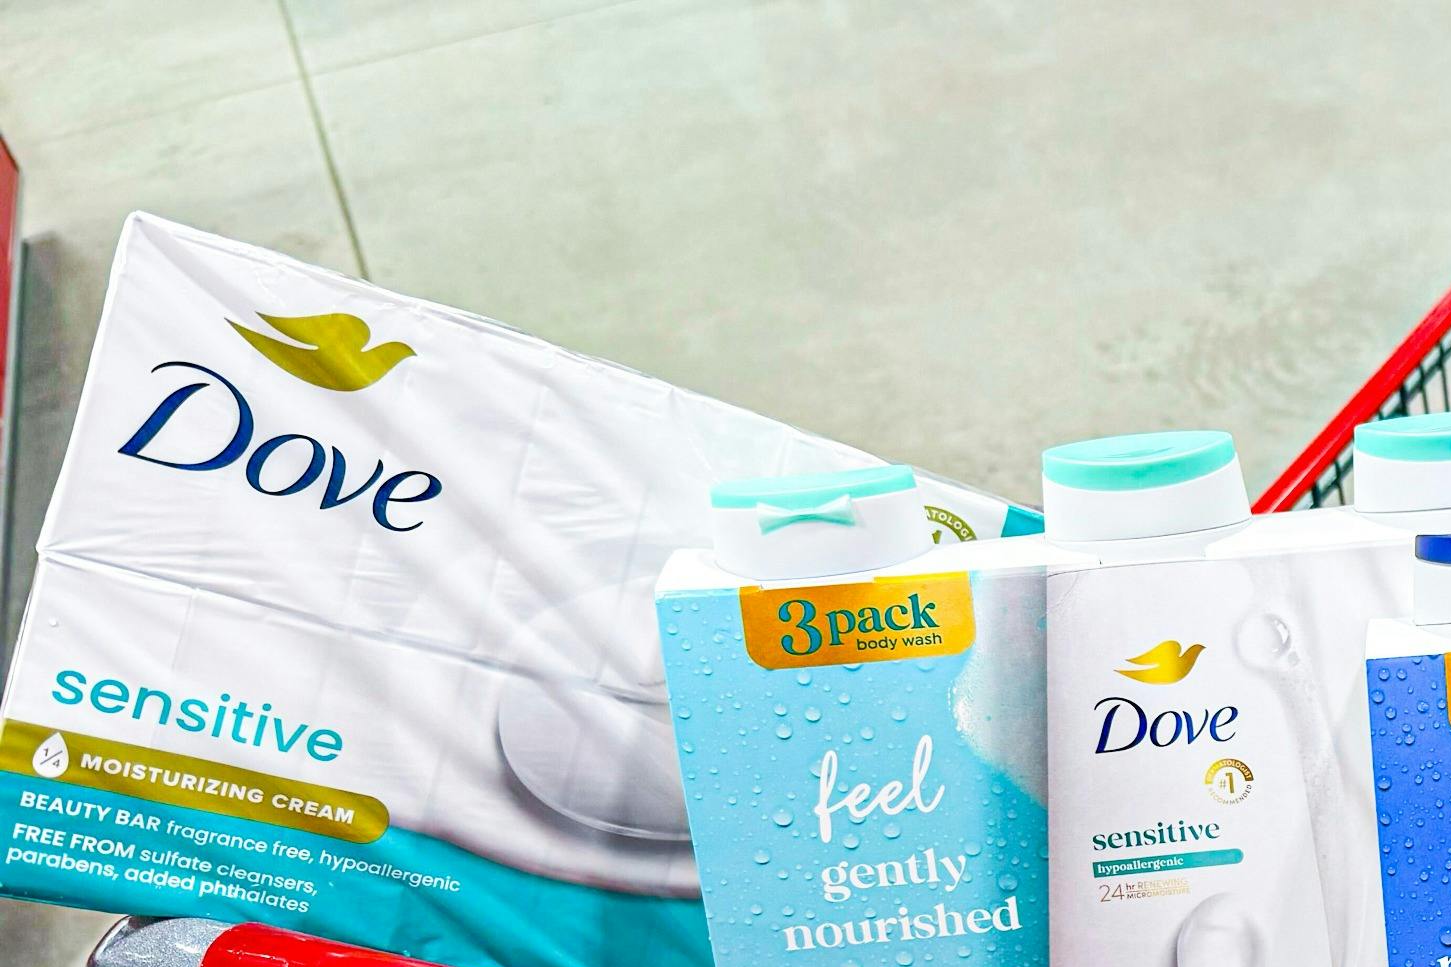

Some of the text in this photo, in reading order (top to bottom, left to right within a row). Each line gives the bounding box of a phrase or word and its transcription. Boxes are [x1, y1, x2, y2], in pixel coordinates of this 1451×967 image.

[118, 361, 442, 532] Dove
[826, 593, 939, 646] pack
[857, 632, 941, 652] body wash
[51, 668, 344, 763] sensitive
[1093, 697, 1239, 754] Dove
[81, 753, 355, 825] MOISTURIZING CREAM
[814, 735, 945, 843] feel
[12, 823, 318, 897] FREE FROM sulfate cleansers,
[20, 791, 461, 893] BEAUTY BAR fragrance free, hypoallergenic
[1093, 820, 1220, 851] sensitive
[5, 846, 310, 913] parabens, added phthalates
[821, 849, 966, 902] gently
[1097, 856, 1184, 875] hypoallergenic
[1099, 884, 1125, 903] 24
[1126, 882, 1135, 891] hr
[784, 897, 1022, 951] nourished
